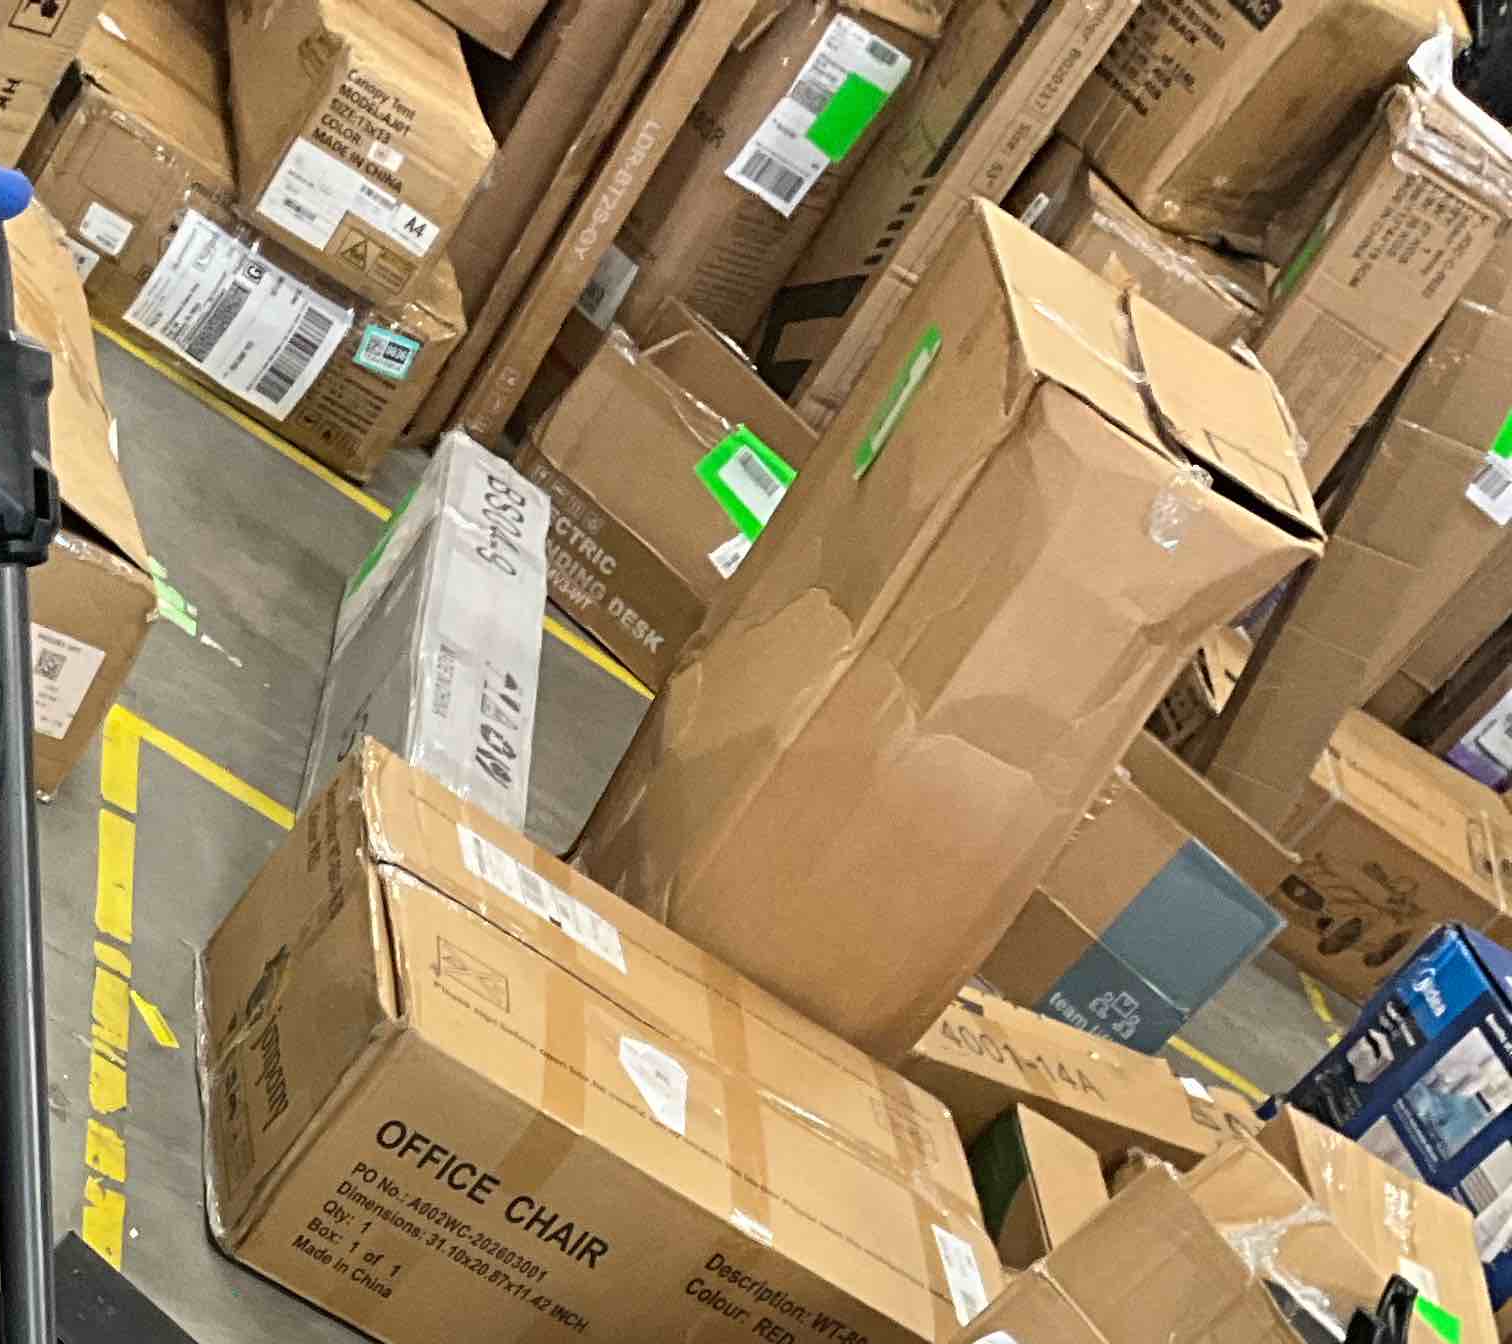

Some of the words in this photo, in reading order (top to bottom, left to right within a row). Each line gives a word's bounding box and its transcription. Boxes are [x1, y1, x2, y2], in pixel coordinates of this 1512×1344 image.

[348, 69, 389, 103] Canopy
[312, 128, 349, 160] MADE
[365, 162, 402, 193] CHINA
[403, 215, 427, 239] A4
[350, 1160, 378, 1186] PO
[371, 1114, 501, 1208] OFFICE
[500, 1189, 611, 1271] CHAIR
[305, 1215, 344, 1245] Box:
[319, 1196, 356, 1228] Qty:
[334, 1179, 428, 1242] Dimensions:
[290, 1232, 336, 1267] Made
[349, 1265, 395, 1300] China
[702, 1250, 812, 1328] Description:
